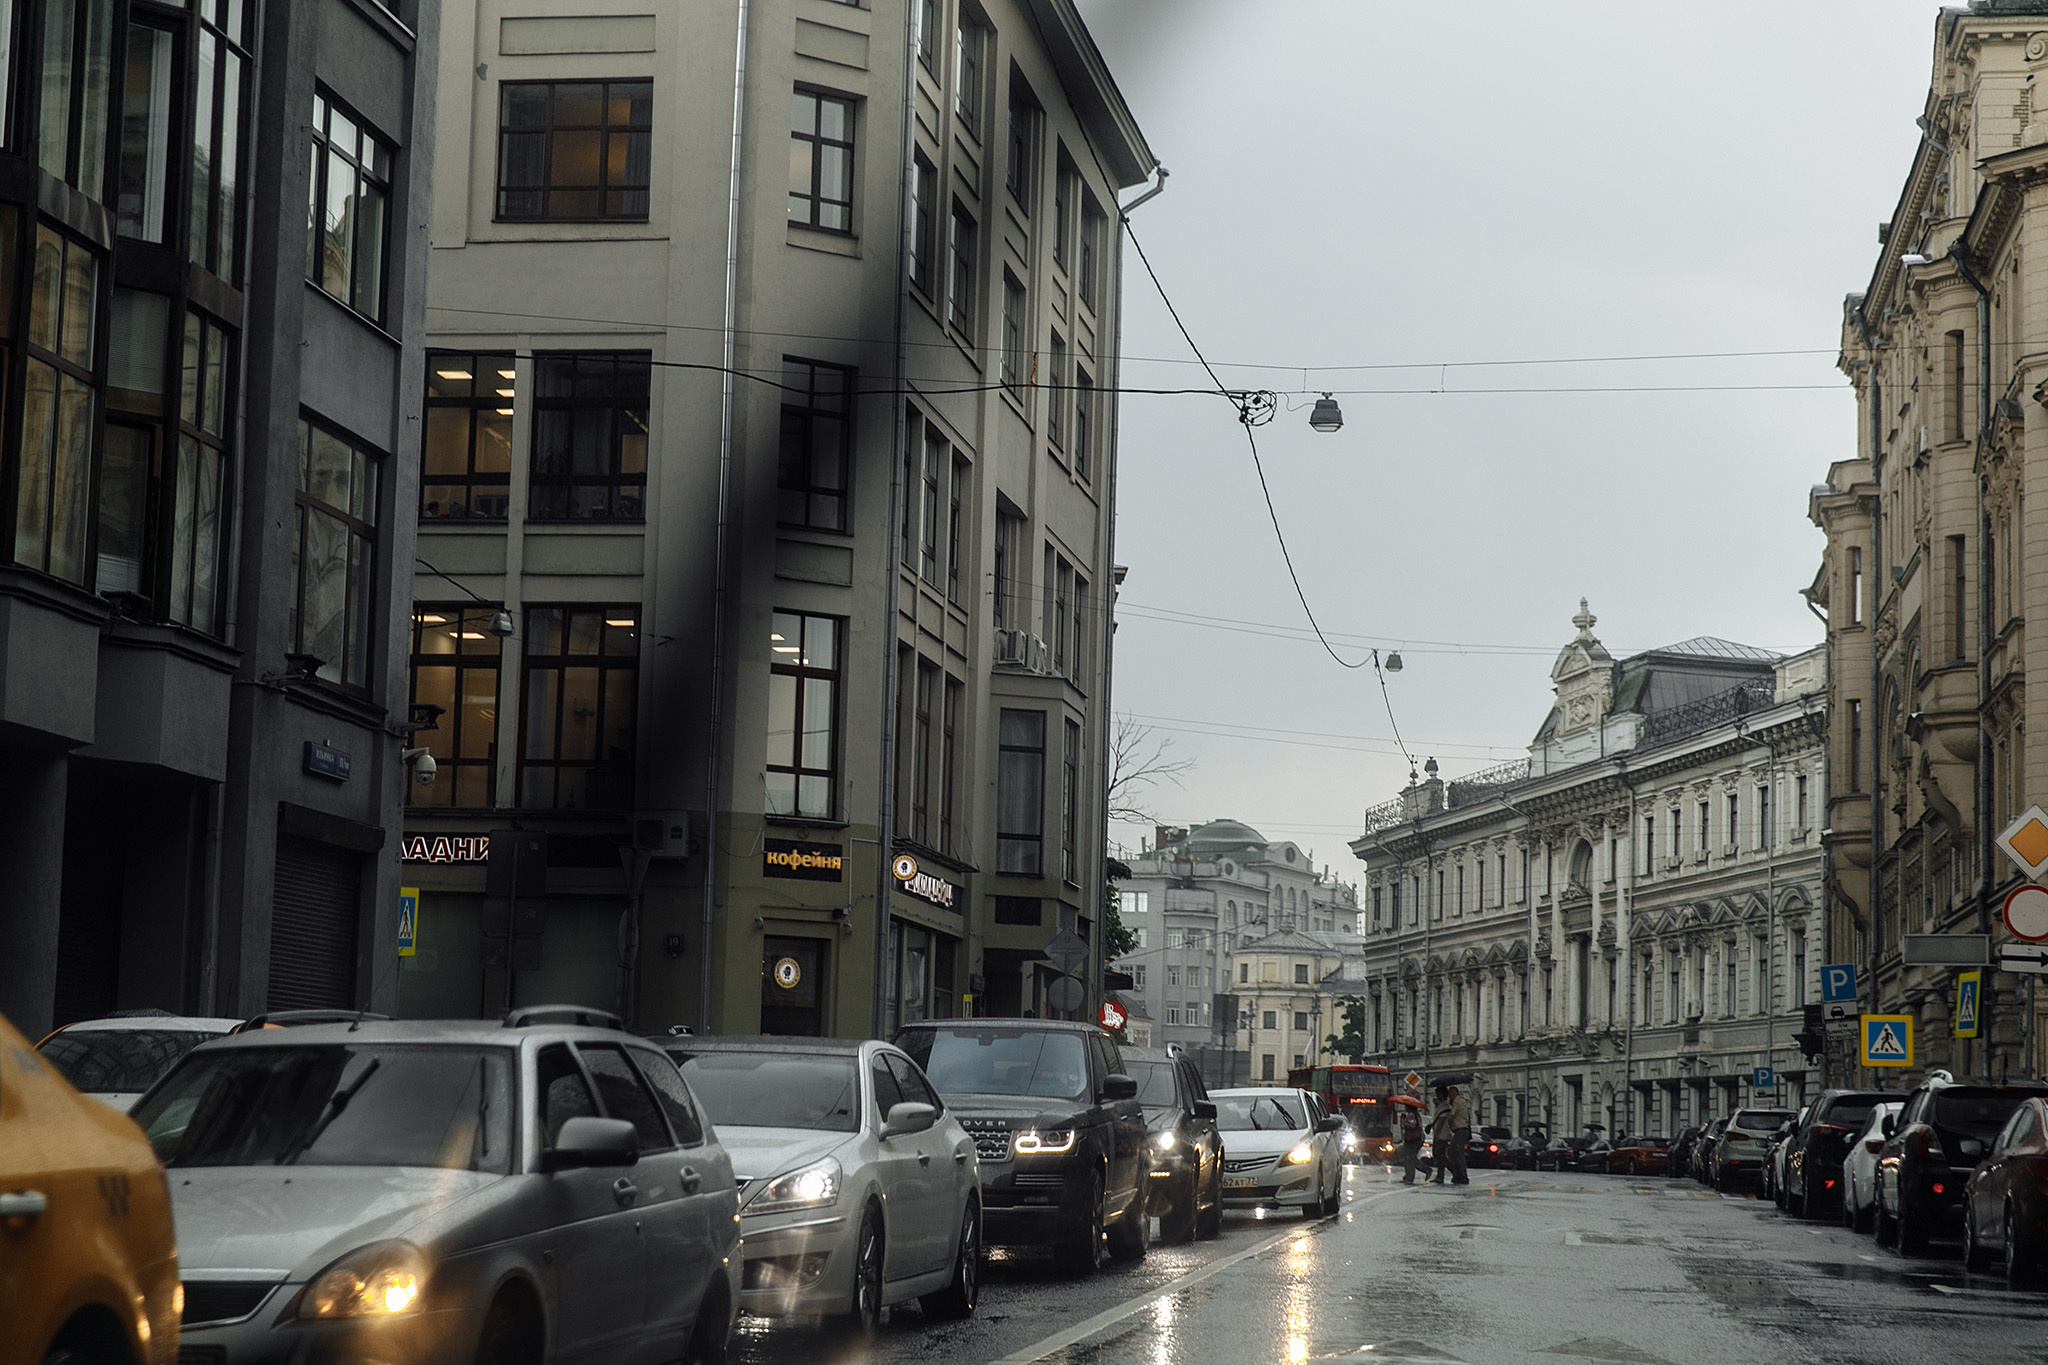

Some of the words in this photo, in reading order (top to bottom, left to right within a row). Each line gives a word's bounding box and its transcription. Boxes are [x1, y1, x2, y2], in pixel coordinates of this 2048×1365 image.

[766, 849, 842, 870] кофейня
[669, 937, 679, 946] 19
[1829, 969, 1848, 997] P
[1758, 1069, 1769, 1085] P
